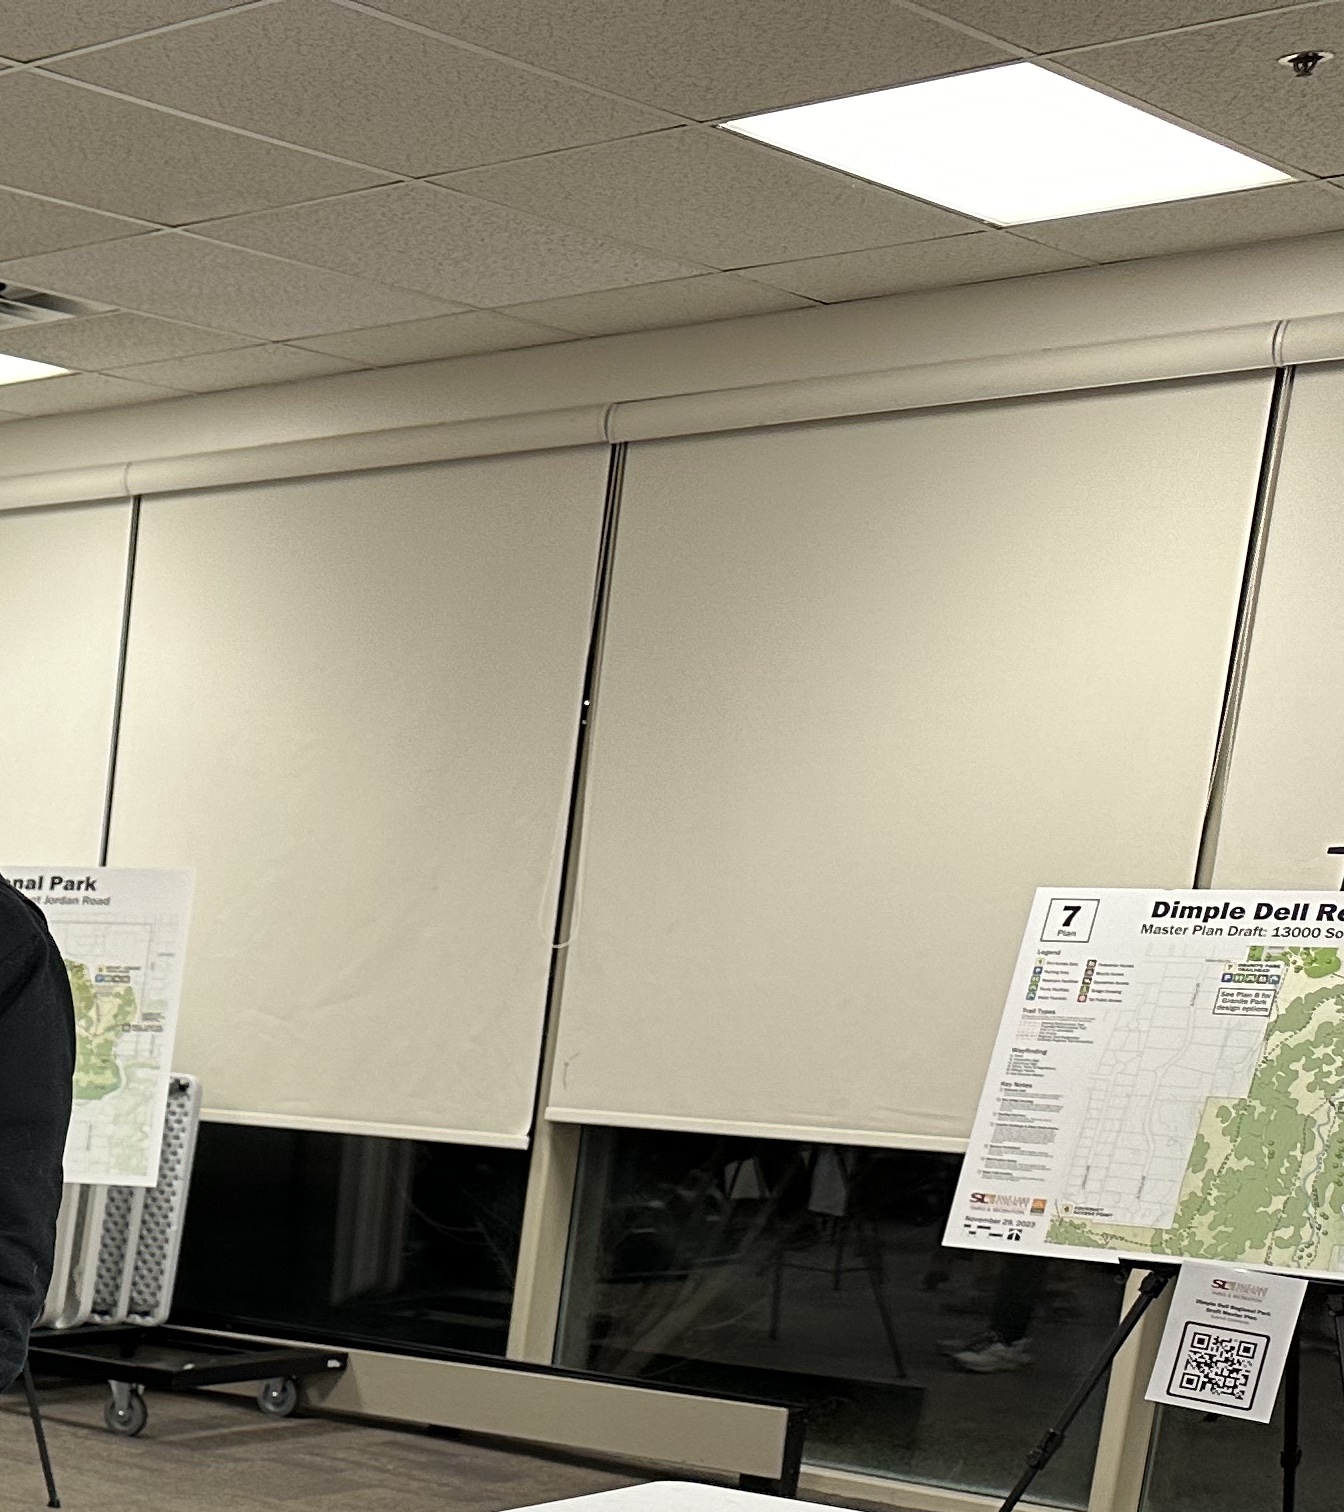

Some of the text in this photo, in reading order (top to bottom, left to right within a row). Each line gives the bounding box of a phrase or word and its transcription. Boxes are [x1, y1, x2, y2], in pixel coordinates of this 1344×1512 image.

[50, 876, 97, 891] Park
[1061, 905, 1082, 927] 7
[1151, 900, 1246, 923] Dimple
[1253, 903, 1309, 921] Dell
[1140, 923, 1189, 936] Master
[1192, 925, 1223, 936] Plan
[1228, 926, 1267, 938] Draft:
[1272, 927, 1321, 939] 13000
